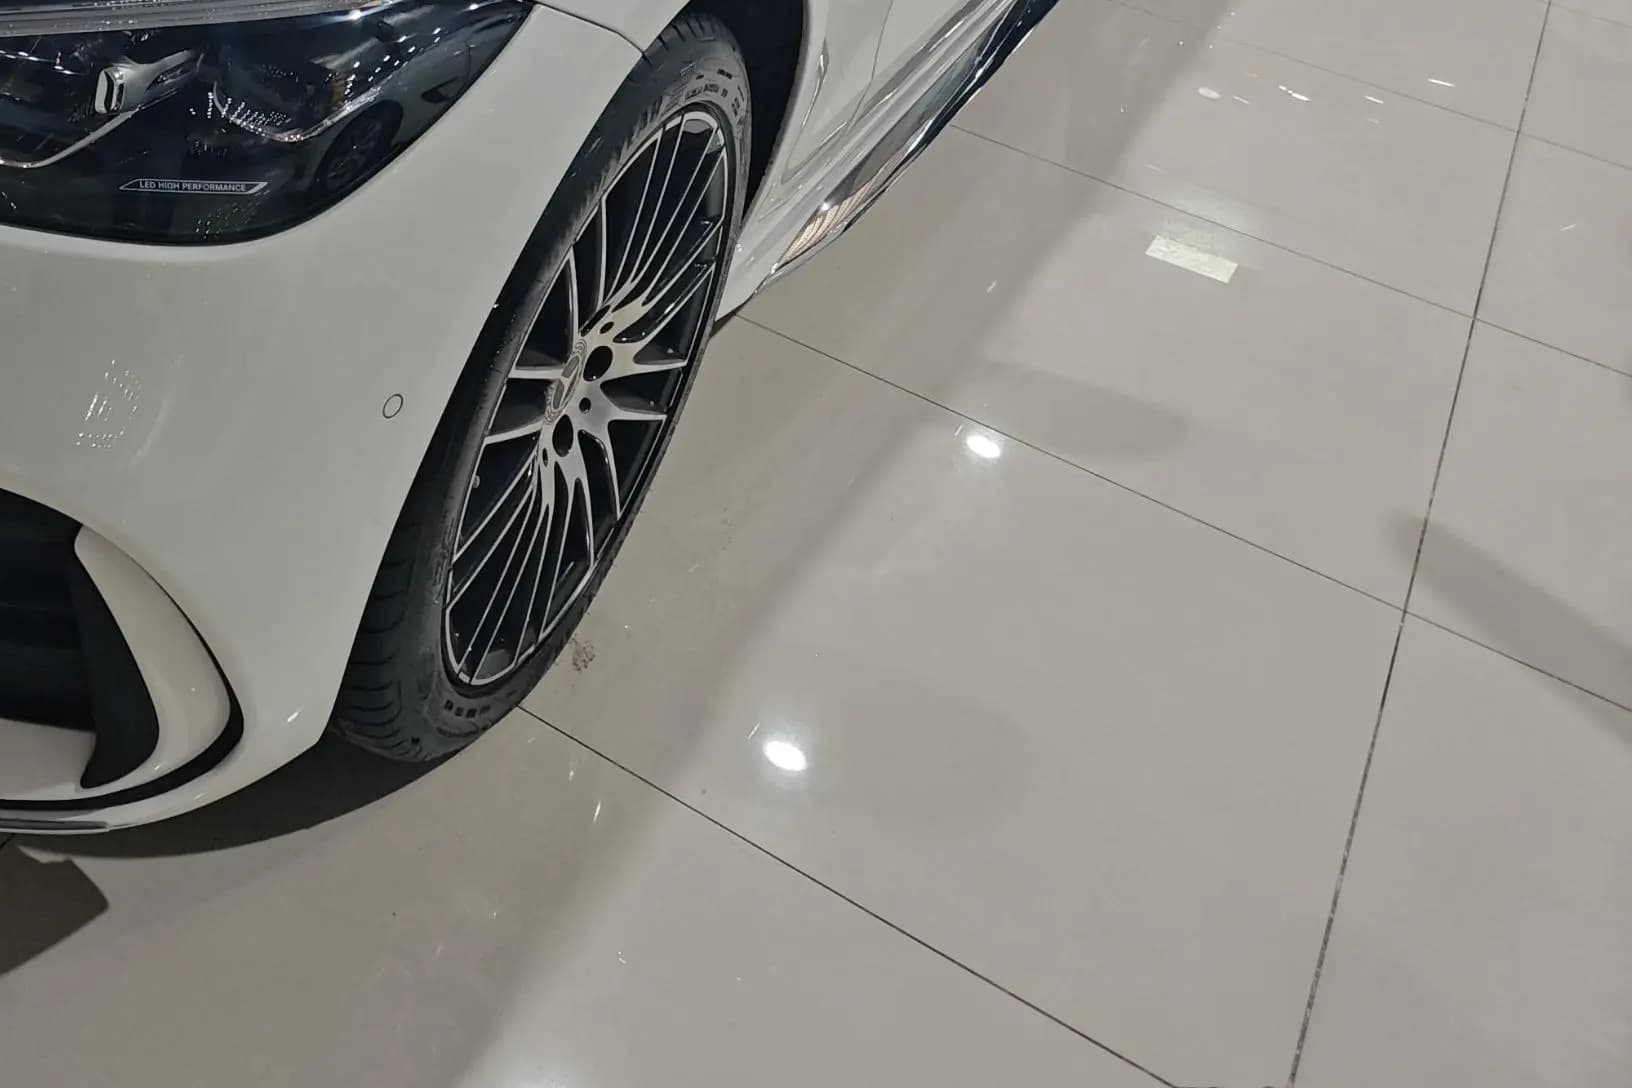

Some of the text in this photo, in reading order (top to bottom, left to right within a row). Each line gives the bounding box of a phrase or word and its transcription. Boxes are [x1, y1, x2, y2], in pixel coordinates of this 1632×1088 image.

[139, 179, 247, 192] LED HIGH PERFORMANCE
